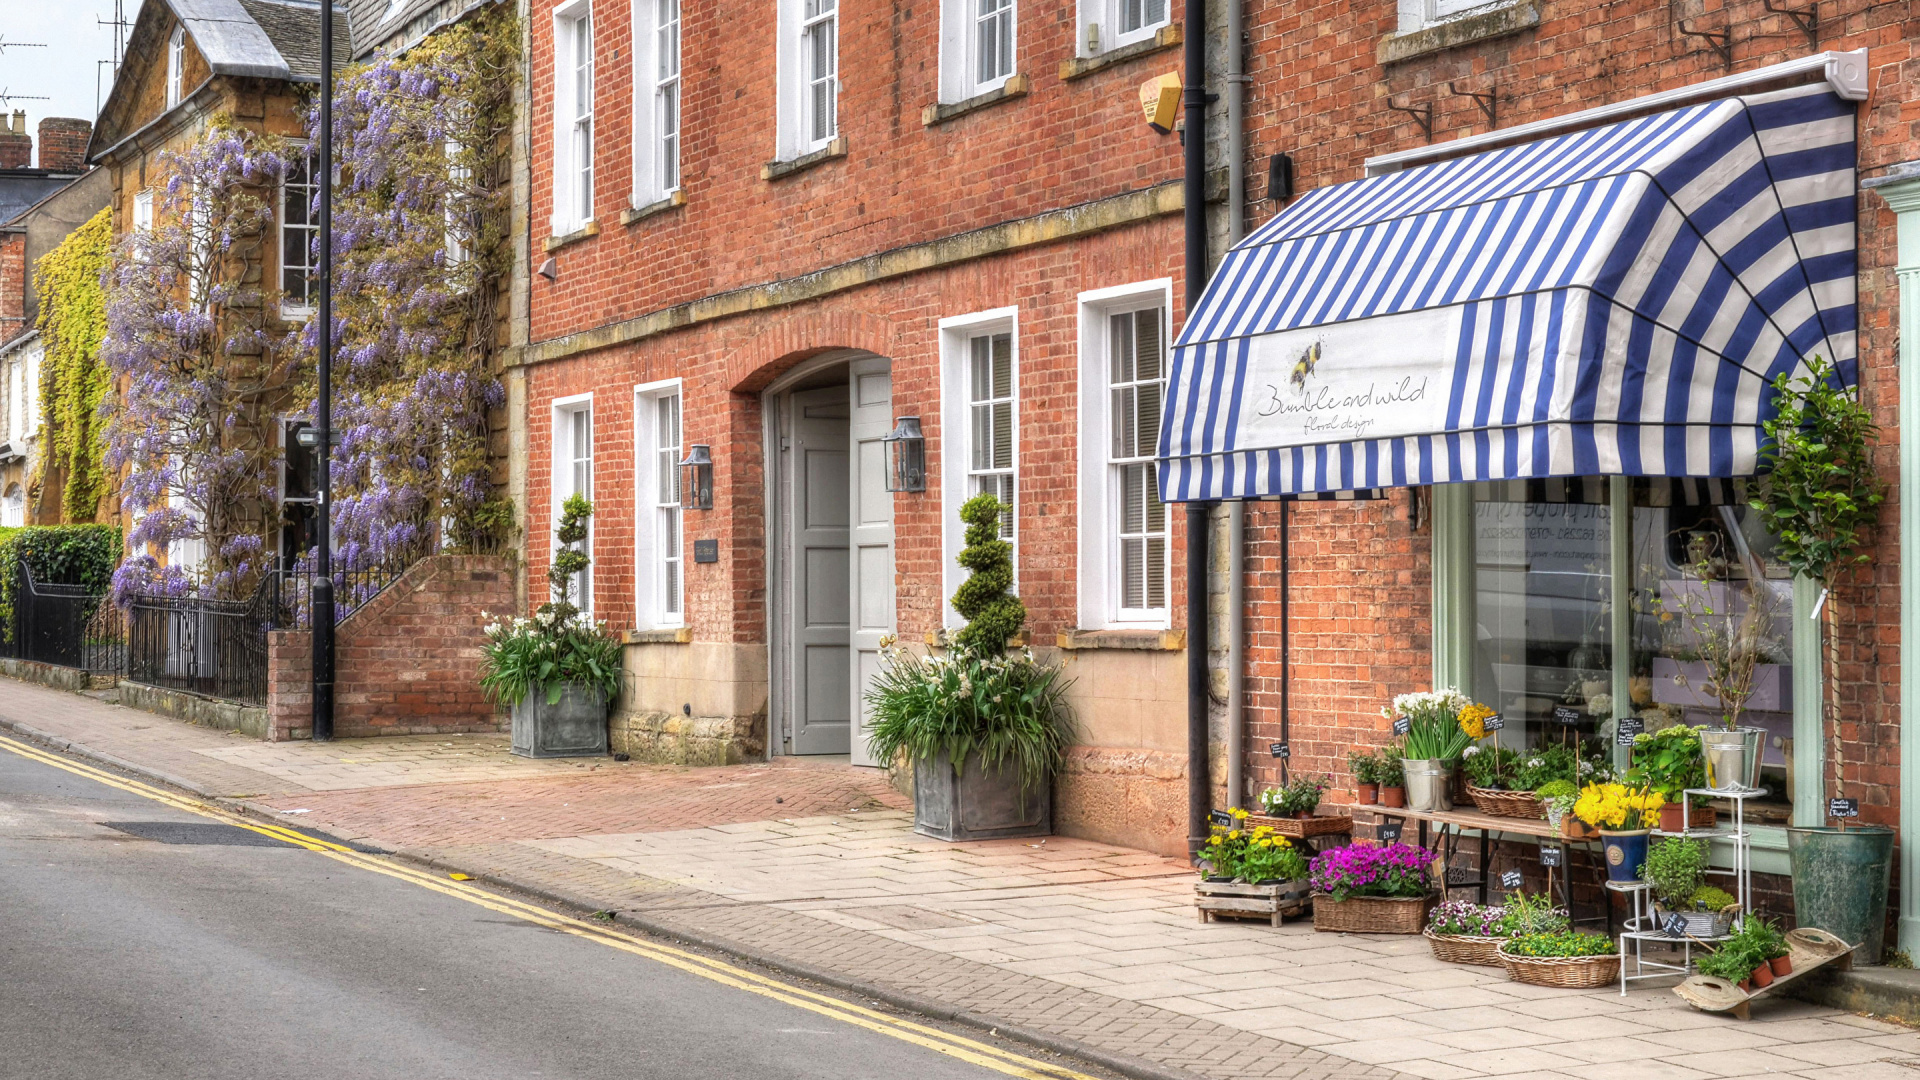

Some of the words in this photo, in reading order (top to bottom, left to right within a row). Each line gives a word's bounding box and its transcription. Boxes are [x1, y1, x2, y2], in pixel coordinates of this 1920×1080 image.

[1258, 384, 1341, 416] Bumble
[1343, 382, 1375, 407] and
[1376, 376, 1428, 402] wild
[1304, 415, 1340, 436] floral
[1341, 415, 1374, 438] design
